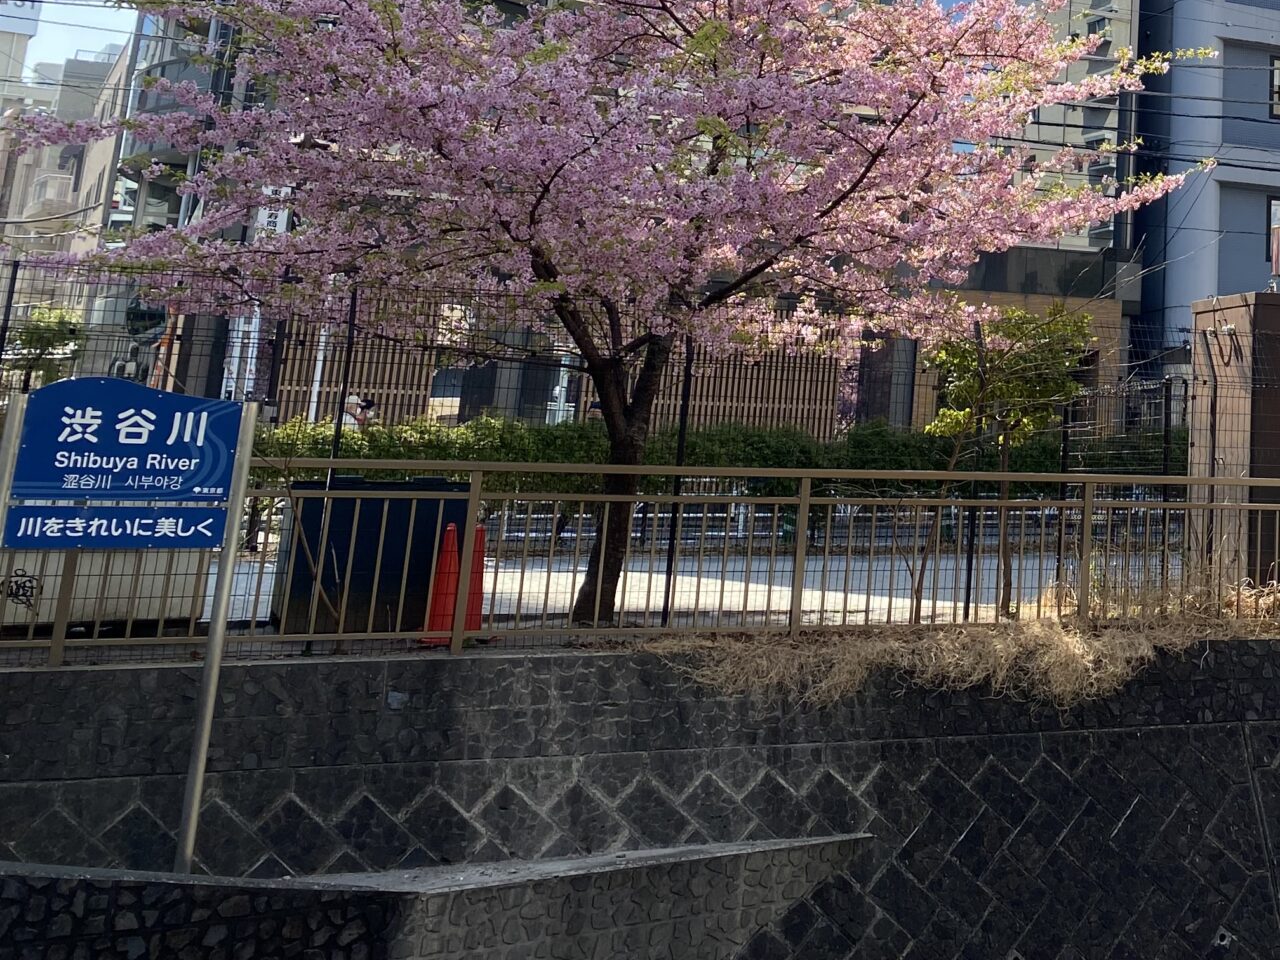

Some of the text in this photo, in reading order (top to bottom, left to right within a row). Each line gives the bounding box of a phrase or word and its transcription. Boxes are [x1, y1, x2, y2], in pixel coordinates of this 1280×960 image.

[57, 406, 208, 447] 渋谷川
[54, 451, 200, 472] Shibuya River
[124, 475, 184, 490] 시부야강
[16, 517, 213, 538] 川をきれいに美しく
